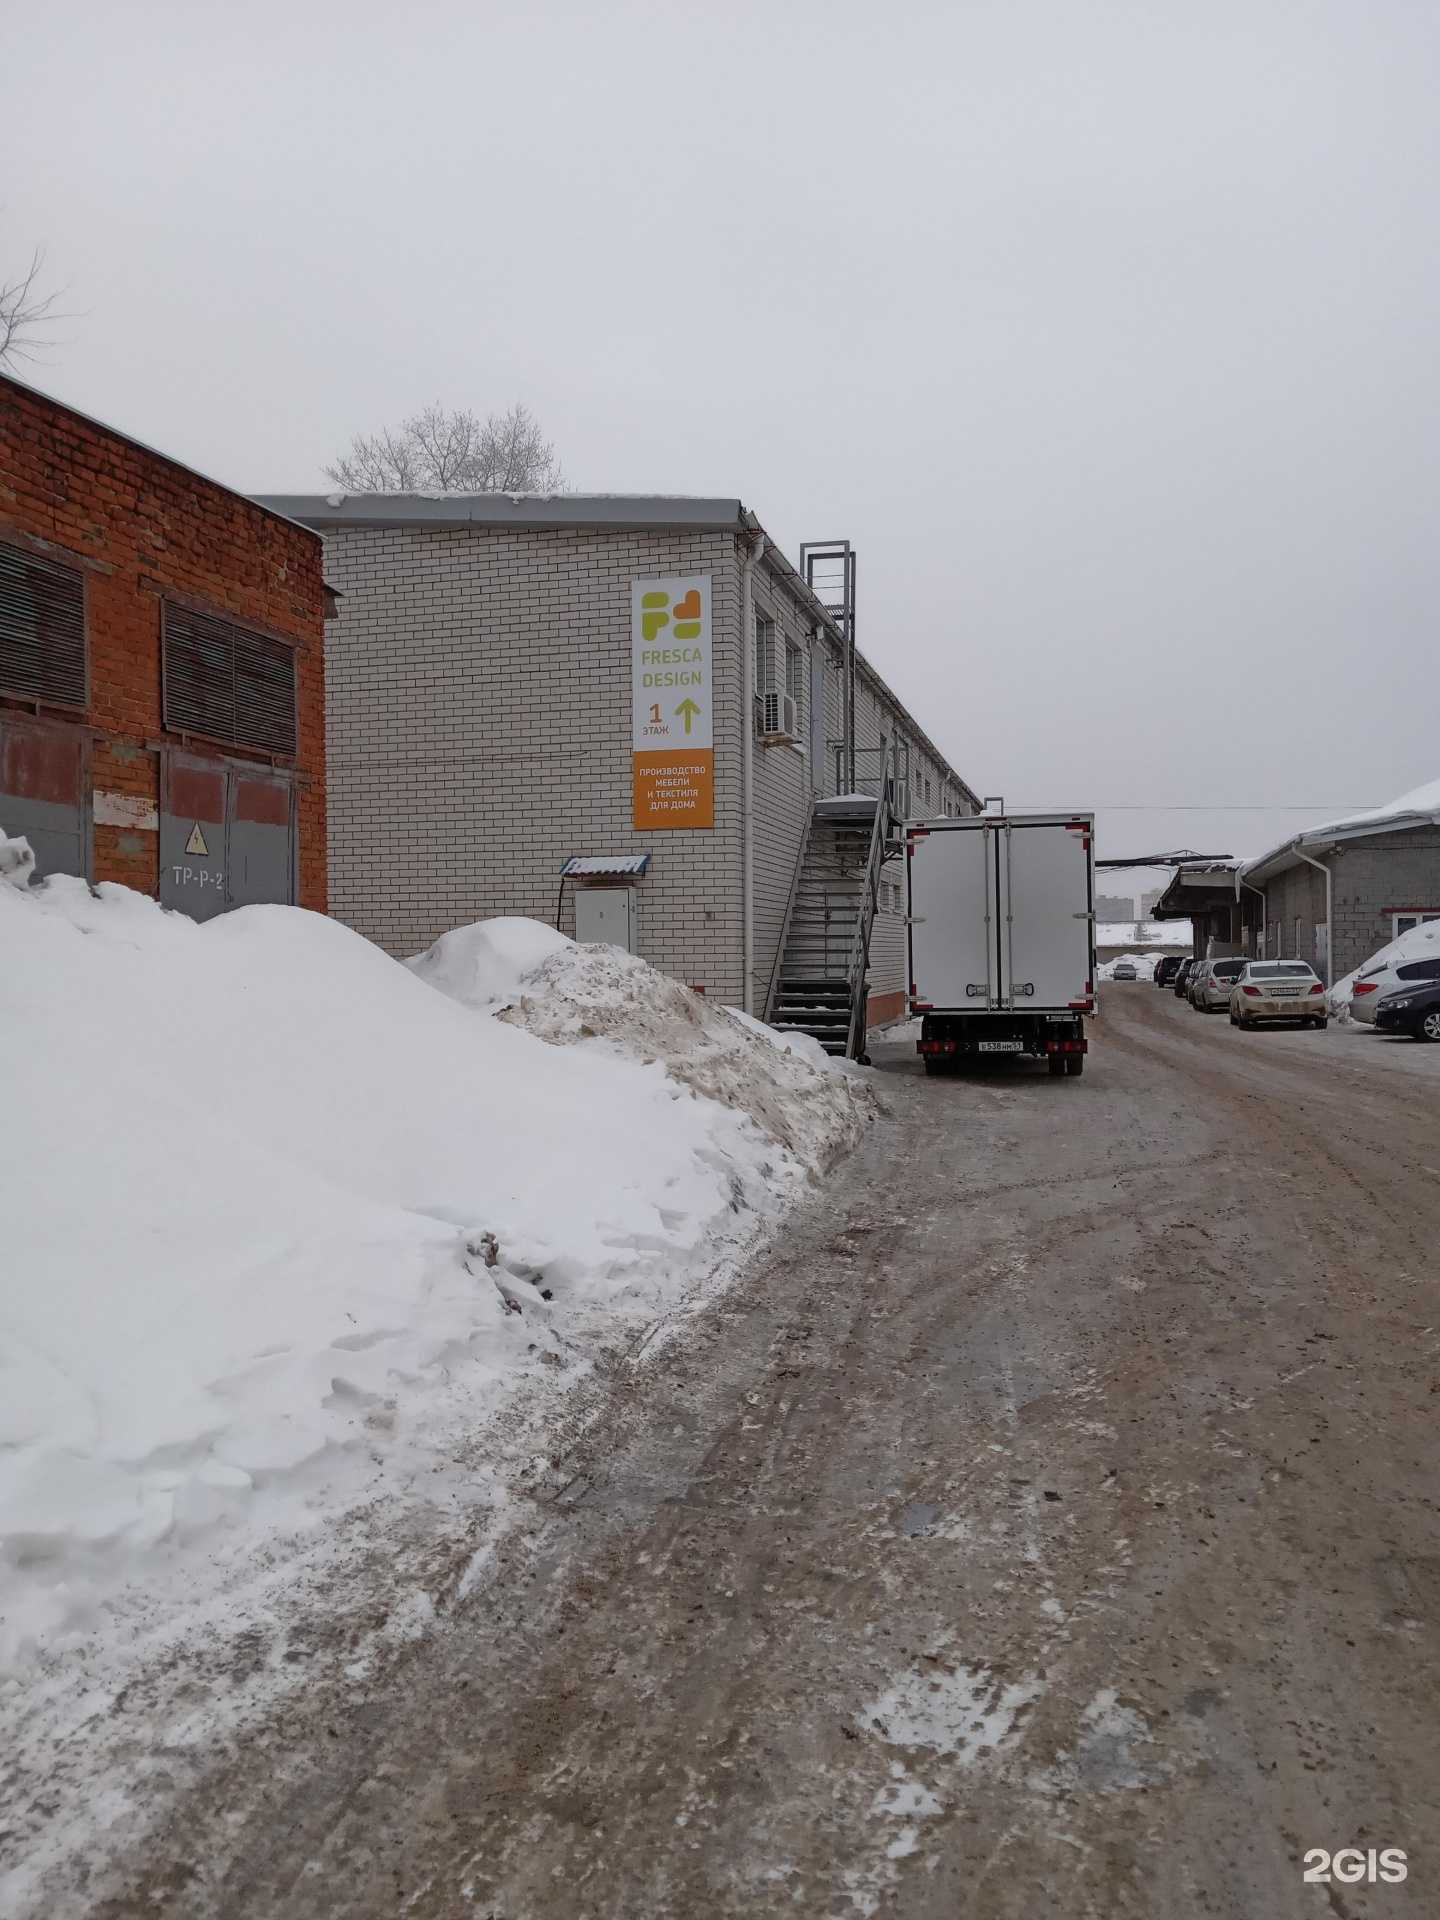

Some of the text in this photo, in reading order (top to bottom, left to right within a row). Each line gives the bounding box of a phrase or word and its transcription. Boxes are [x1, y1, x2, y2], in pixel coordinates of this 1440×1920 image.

[642, 648, 702, 665] FRESCA
[642, 671, 702, 688] DESIGN
[649, 703, 663, 723] 1
[642, 725, 670, 736] ЭТАЖ
[639, 766, 706, 776] ПРОИЗВОДСТВО
[655, 778, 690, 787] МЕБЕЛИ
[647, 789, 698, 799] И ТЕКСТИЛЯ
[650, 800, 696, 810] ДЛЯ ДОМА
